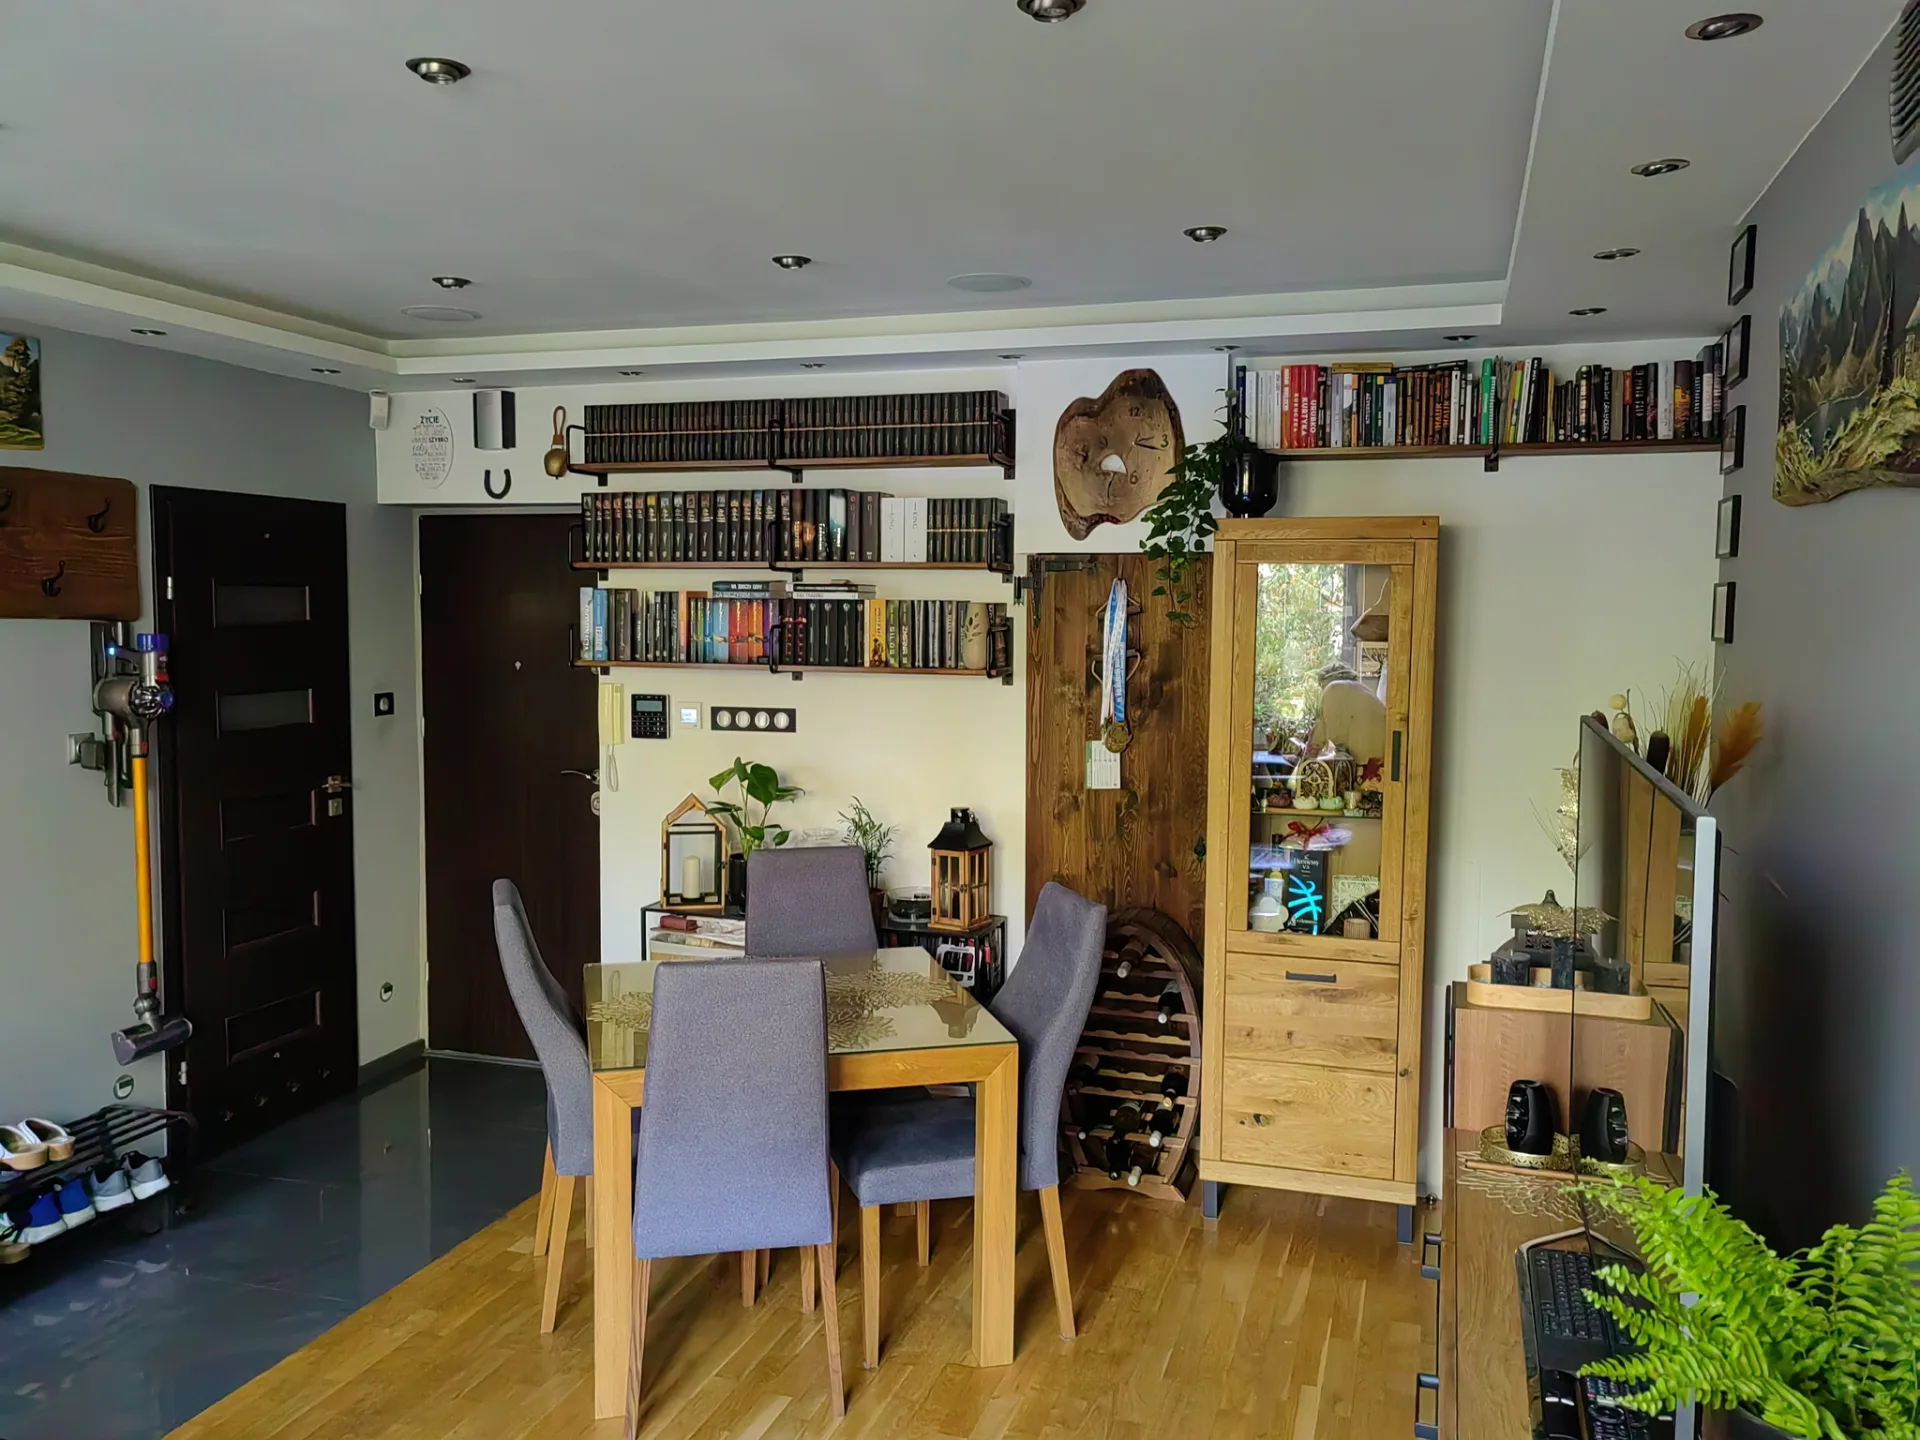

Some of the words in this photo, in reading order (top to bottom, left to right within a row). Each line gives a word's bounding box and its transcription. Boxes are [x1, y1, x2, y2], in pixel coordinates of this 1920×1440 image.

[1129, 407, 1140, 417] 12
[1161, 434, 1169, 448] 3
[1129, 470, 1139, 485] 6
